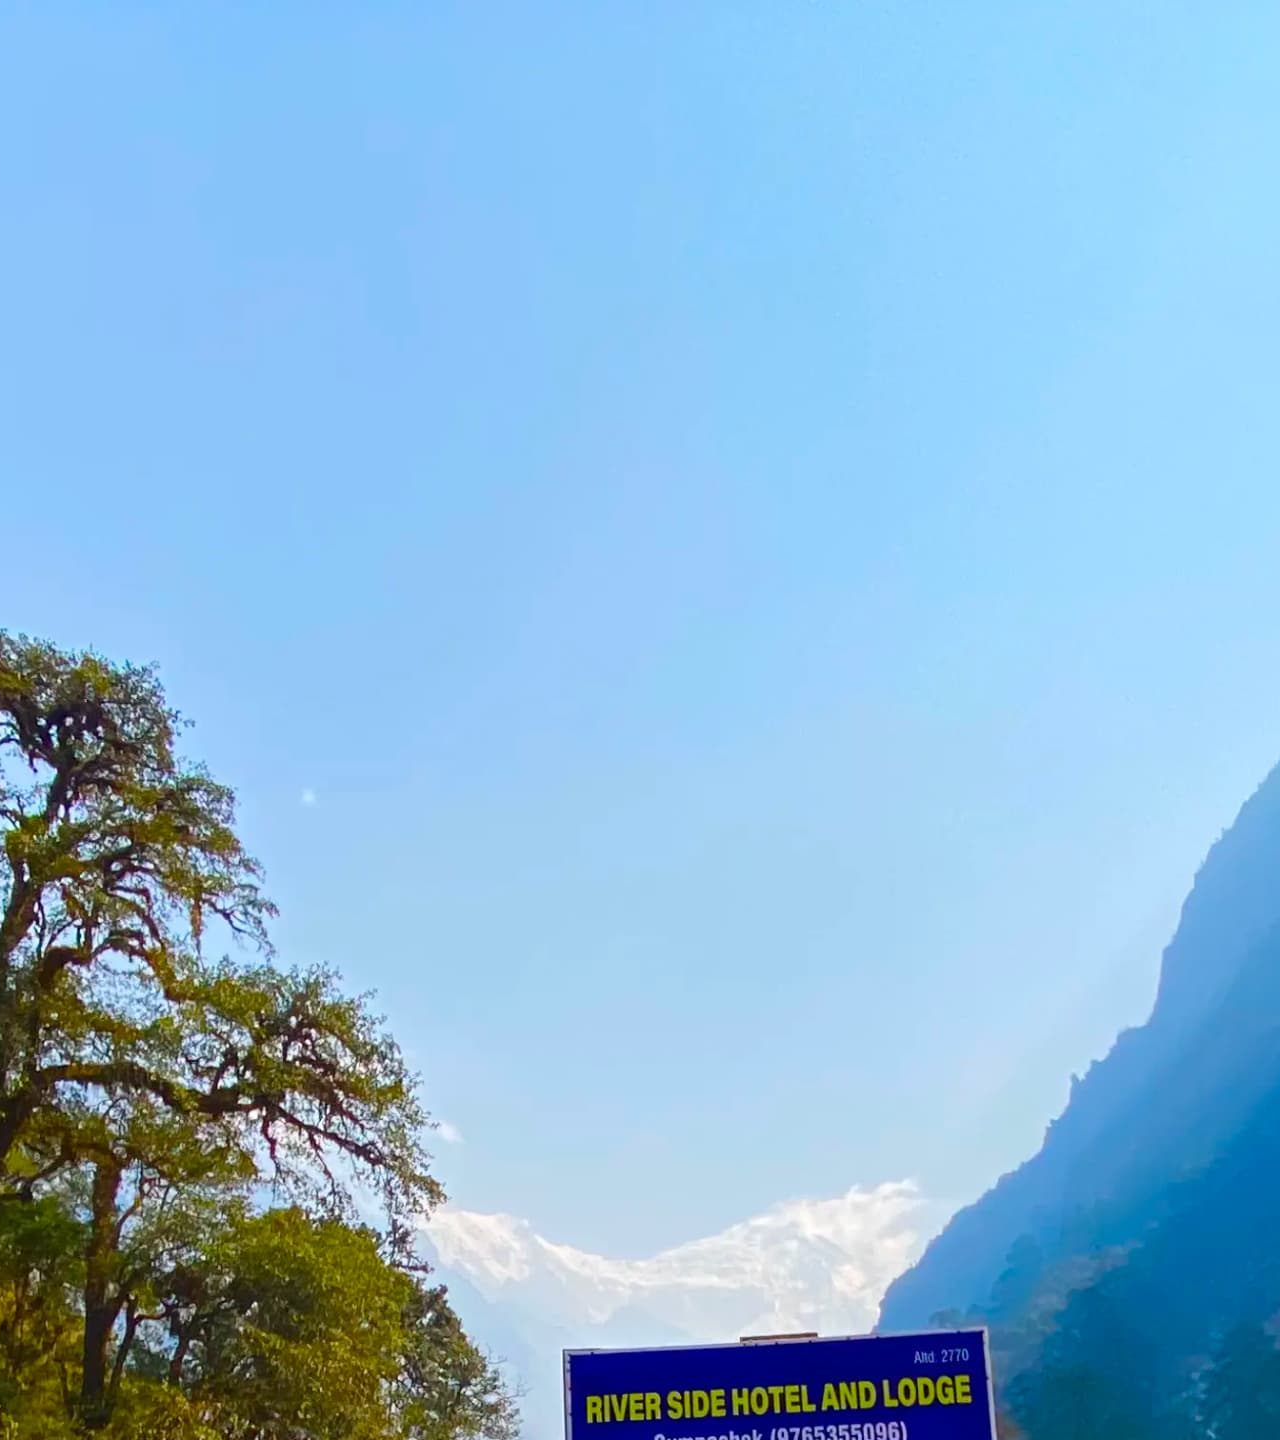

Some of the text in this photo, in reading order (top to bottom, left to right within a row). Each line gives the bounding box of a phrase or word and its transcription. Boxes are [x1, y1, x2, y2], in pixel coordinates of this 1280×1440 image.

[941, 1348, 969, 1363] 2770
[586, 1375, 972, 1423] RIVER SIDE HOTEL AND LODGE
